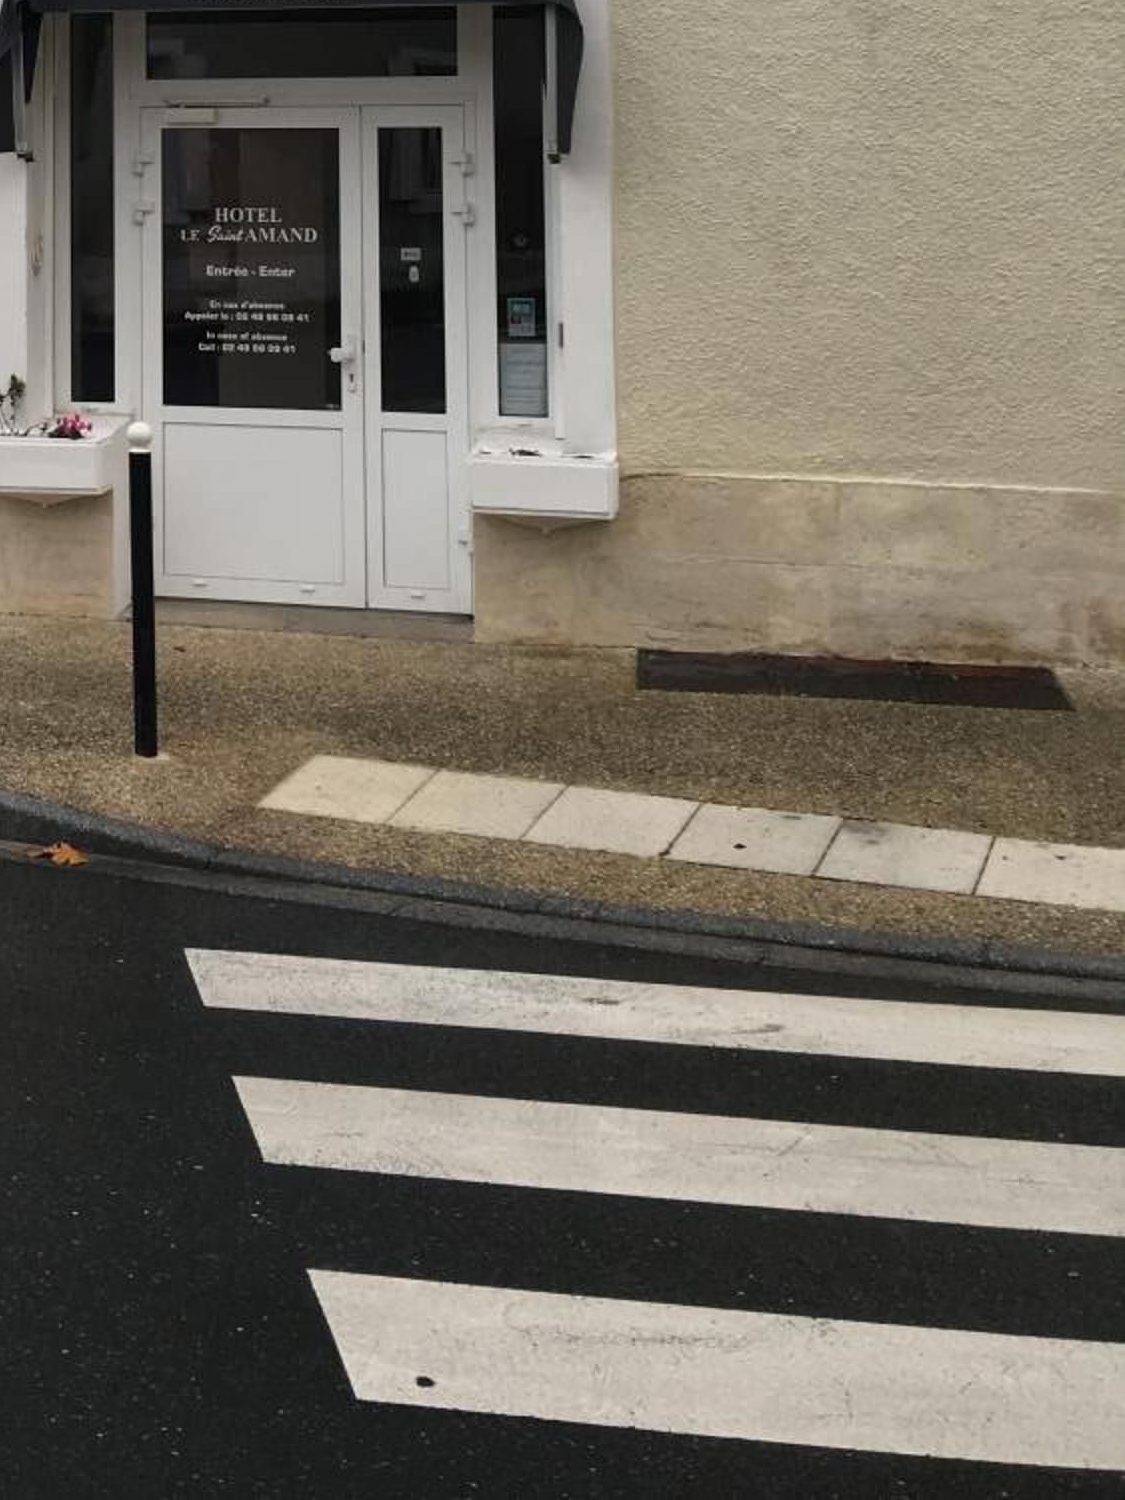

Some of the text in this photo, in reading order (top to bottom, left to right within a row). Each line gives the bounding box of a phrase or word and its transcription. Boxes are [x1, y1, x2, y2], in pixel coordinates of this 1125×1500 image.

[215, 207, 282, 223] HOTEL
[180, 229, 200, 242] LE
[244, 227, 318, 243] AMAND
[259, 265, 296, 277] Enter
